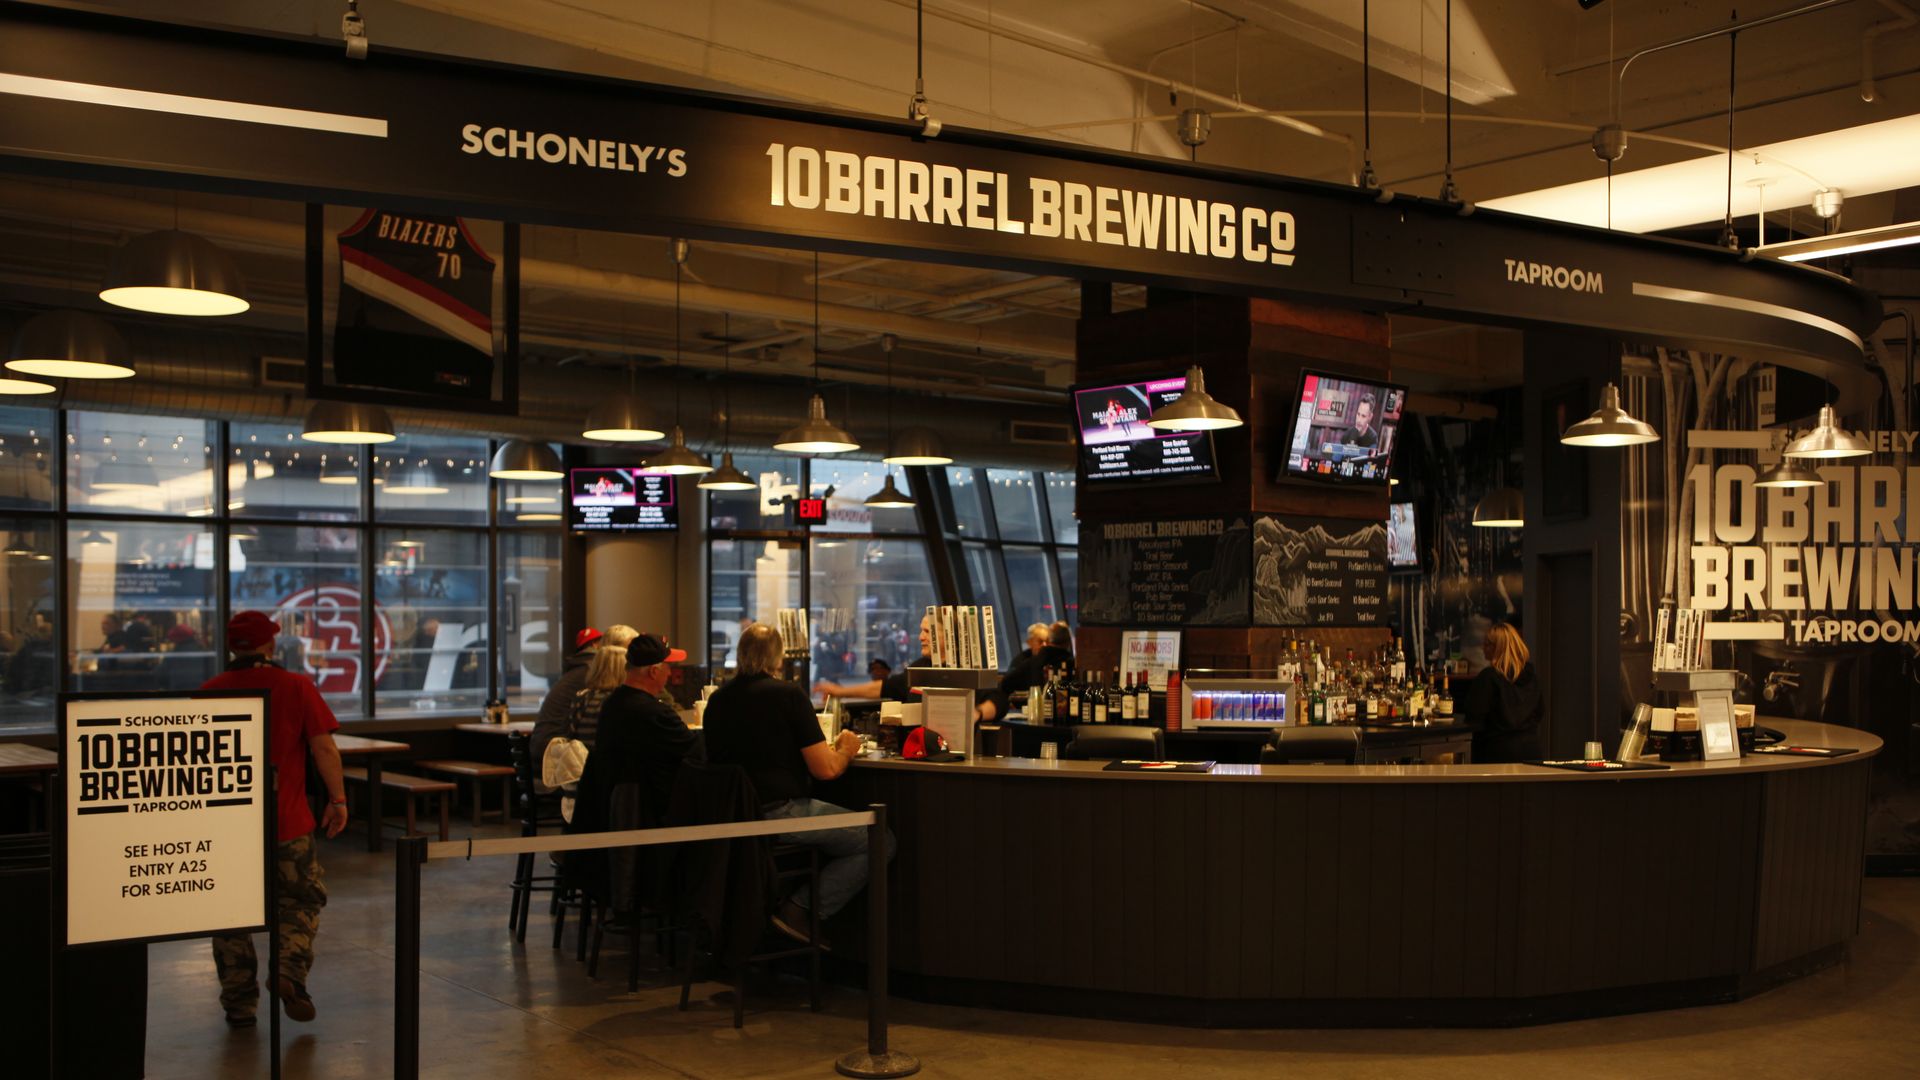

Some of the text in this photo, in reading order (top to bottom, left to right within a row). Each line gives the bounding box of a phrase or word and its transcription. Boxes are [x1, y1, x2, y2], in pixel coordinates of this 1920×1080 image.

[461, 123, 688, 178] SCHONELY'S
[765, 143, 821, 210] 10
[825, 149, 1025, 234] BARREL
[1029, 177, 1236, 259] BREWING
[378, 213, 458, 250] BLAZERS
[436, 252, 462, 280] 70
[1504, 258, 1604, 294] TAPROOM
[799, 499, 823, 519] EXIT
[1687, 464, 1920, 544] 10 BAR
[1114, 521, 1155, 539] BARREL
[1156, 519, 1208, 537] BREWING
[1690, 546, 1920, 611] BREWIN
[1791, 619, 1920, 643] TAPROOM
[1130, 641, 1172, 655] NO MINORS
[125, 714, 209, 727] SCHONELY'S
[77, 729, 252, 770] 10 BARREL
[79, 766, 213, 802] BREWING
[133, 799, 202, 814] TAPROOM
[124, 839, 212, 859] SEE HOST AT
[129, 860, 207, 878] ENTRY A25
[121, 878, 215, 899] FOR SEATING
